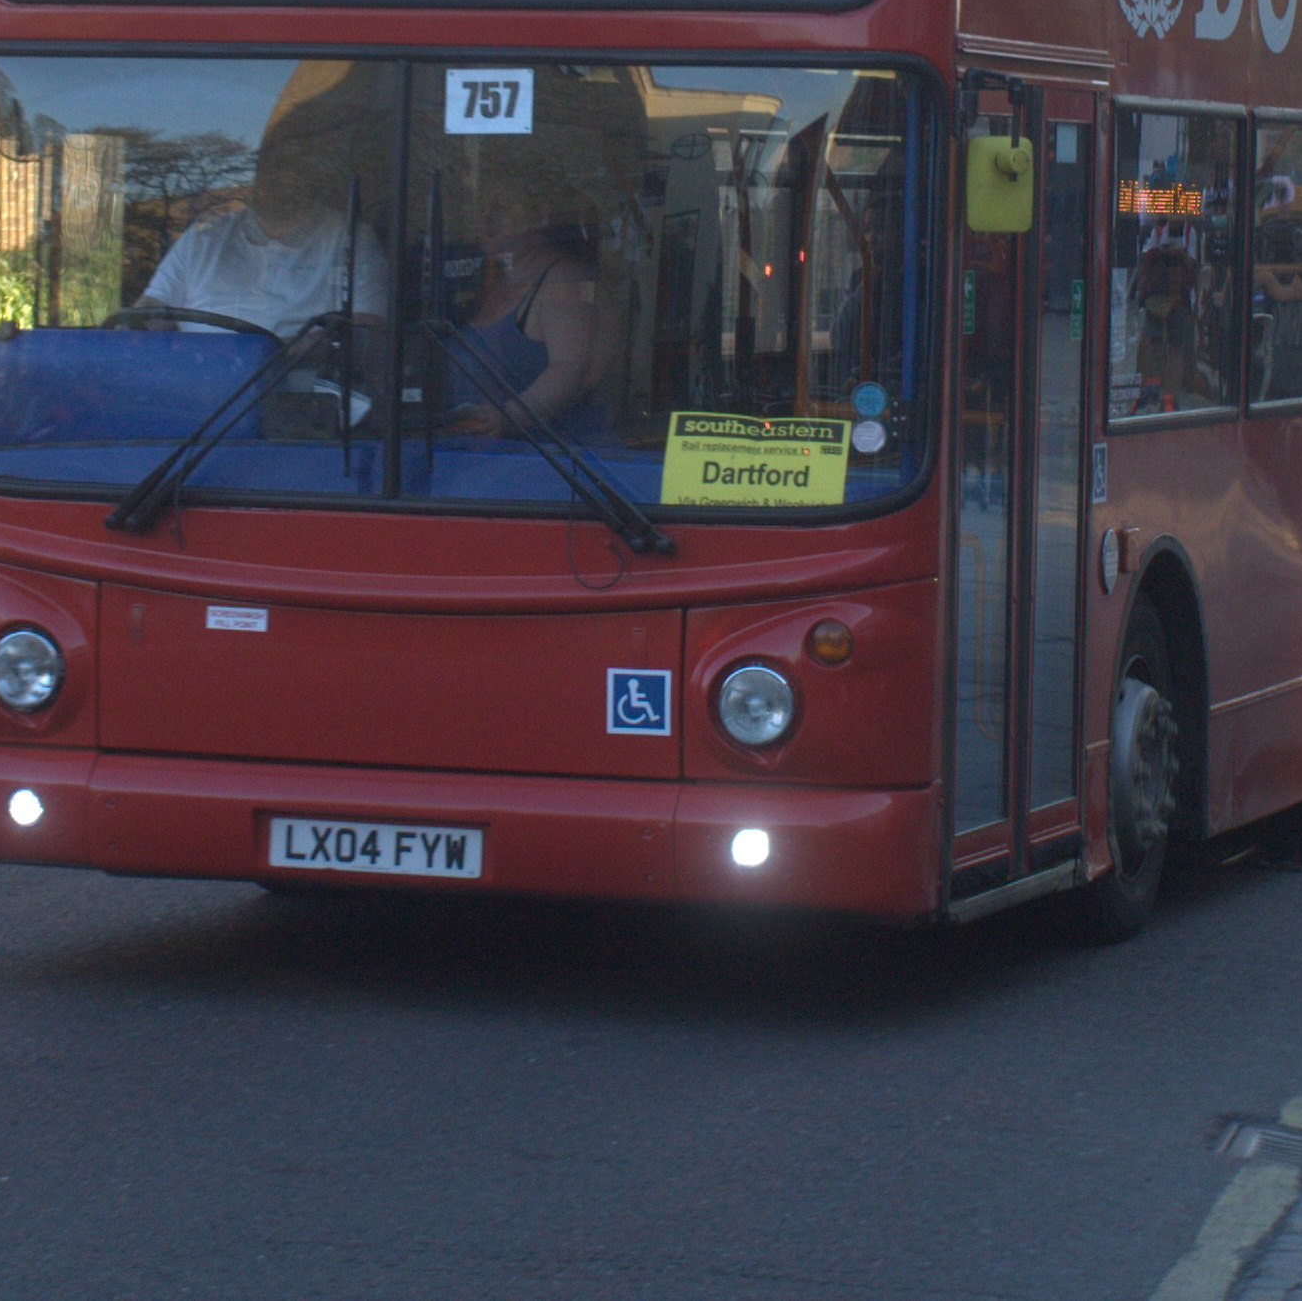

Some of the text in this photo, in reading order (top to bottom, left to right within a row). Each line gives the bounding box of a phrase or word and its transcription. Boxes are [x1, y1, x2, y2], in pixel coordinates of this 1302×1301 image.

[462, 81, 520, 119] 757
[684, 419, 834, 439] southeastern
[681, 440, 700, 452] Rail
[702, 442, 761, 456] replacement
[763, 445, 798, 456] service
[702, 461, 810, 488] Dartford
[285, 824, 467, 870] LX04 FYW
